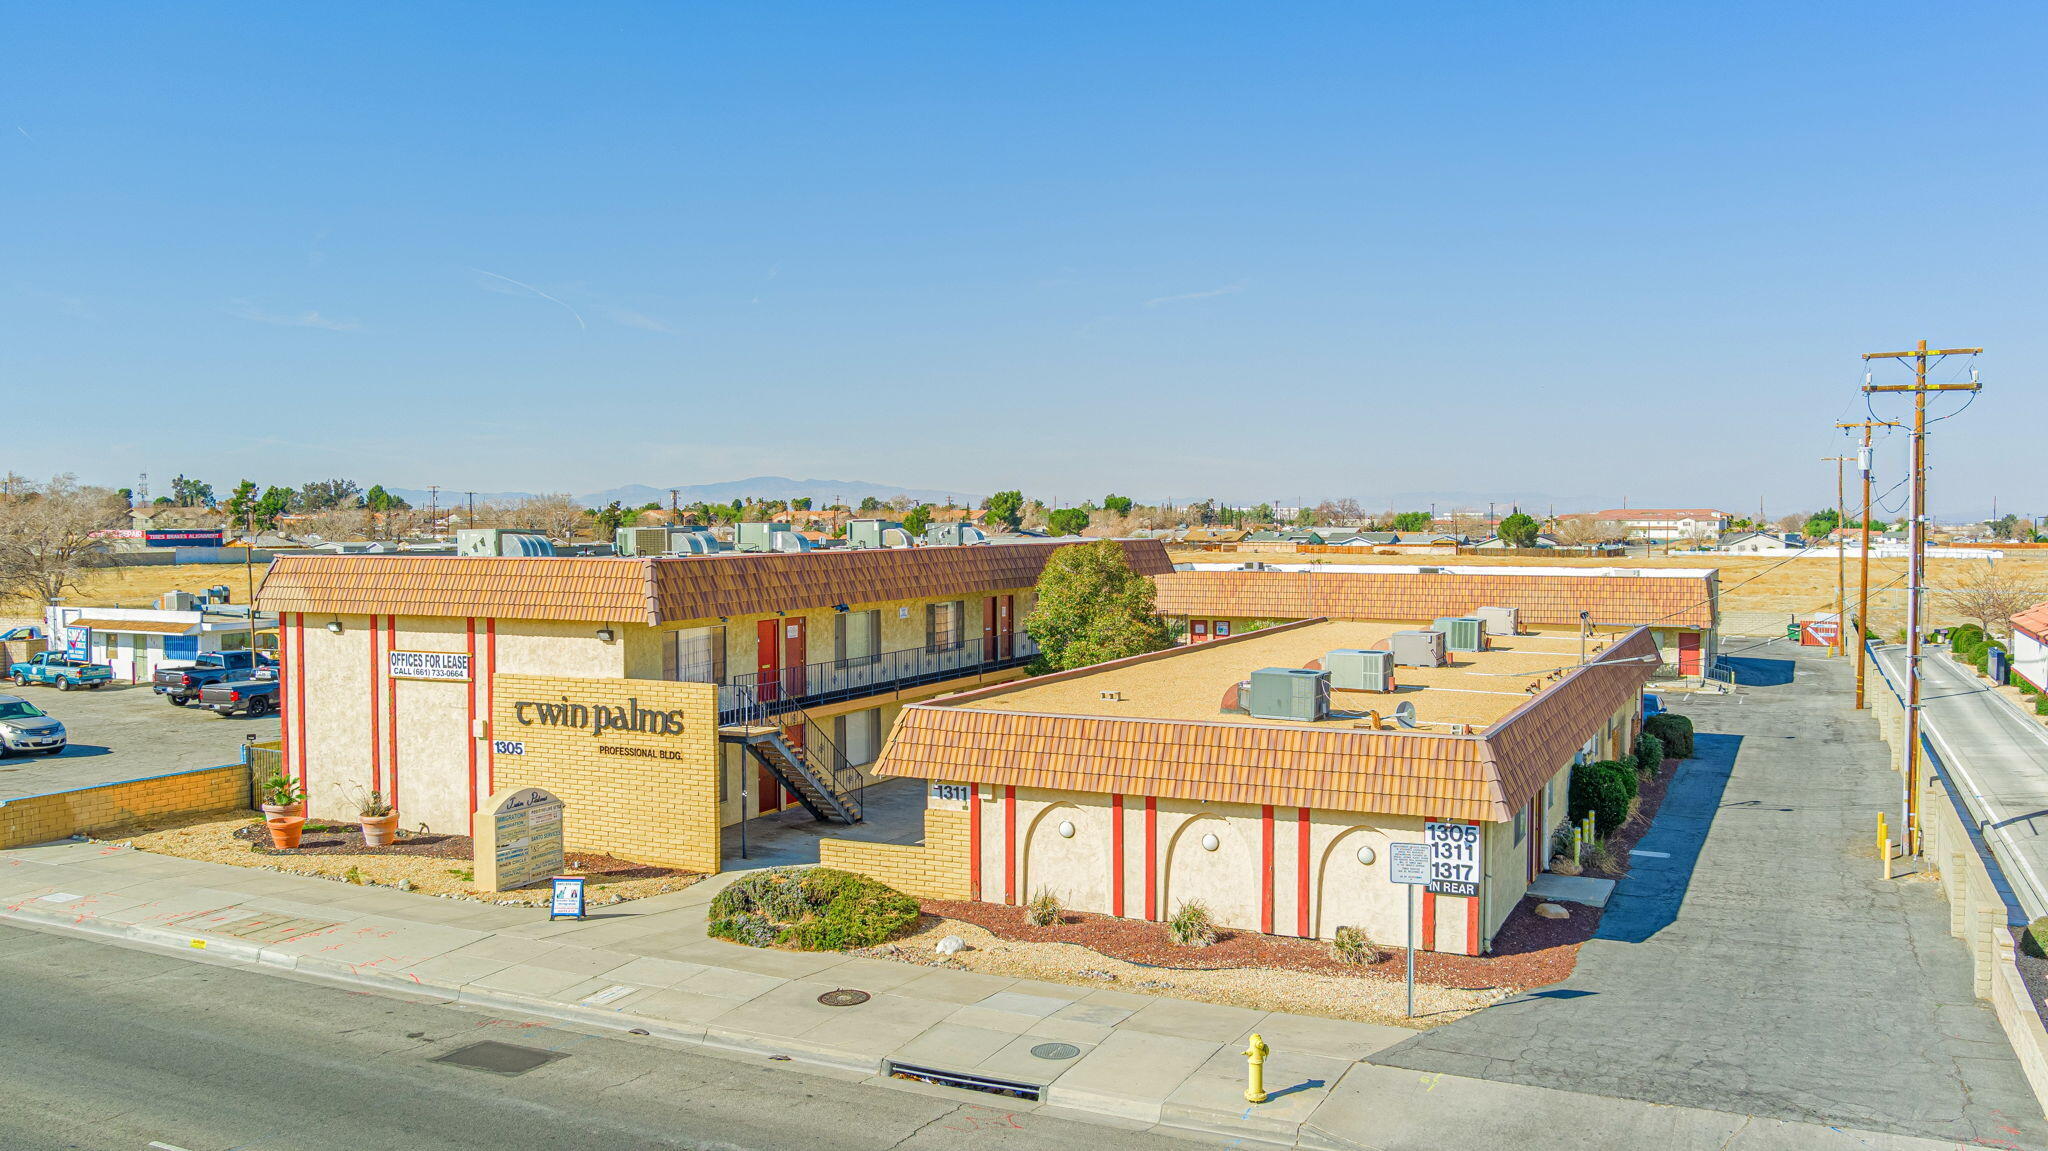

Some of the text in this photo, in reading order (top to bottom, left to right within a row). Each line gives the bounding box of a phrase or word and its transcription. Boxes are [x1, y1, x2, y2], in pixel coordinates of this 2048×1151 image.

[391, 653, 467, 669] OFFICES FOR LEASE
[394, 667, 463, 677] CALL (661) 733-0664
[494, 740, 523, 754] 1305
[599, 745, 684, 760] PROFESSIONAL BLDG.
[934, 785, 967, 801] 1311
[1427, 825, 1477, 843] 1305
[1431, 841, 1473, 861] 1311
[1432, 862, 1473, 880] 1317
[1429, 881, 1474, 894] IN REAR
